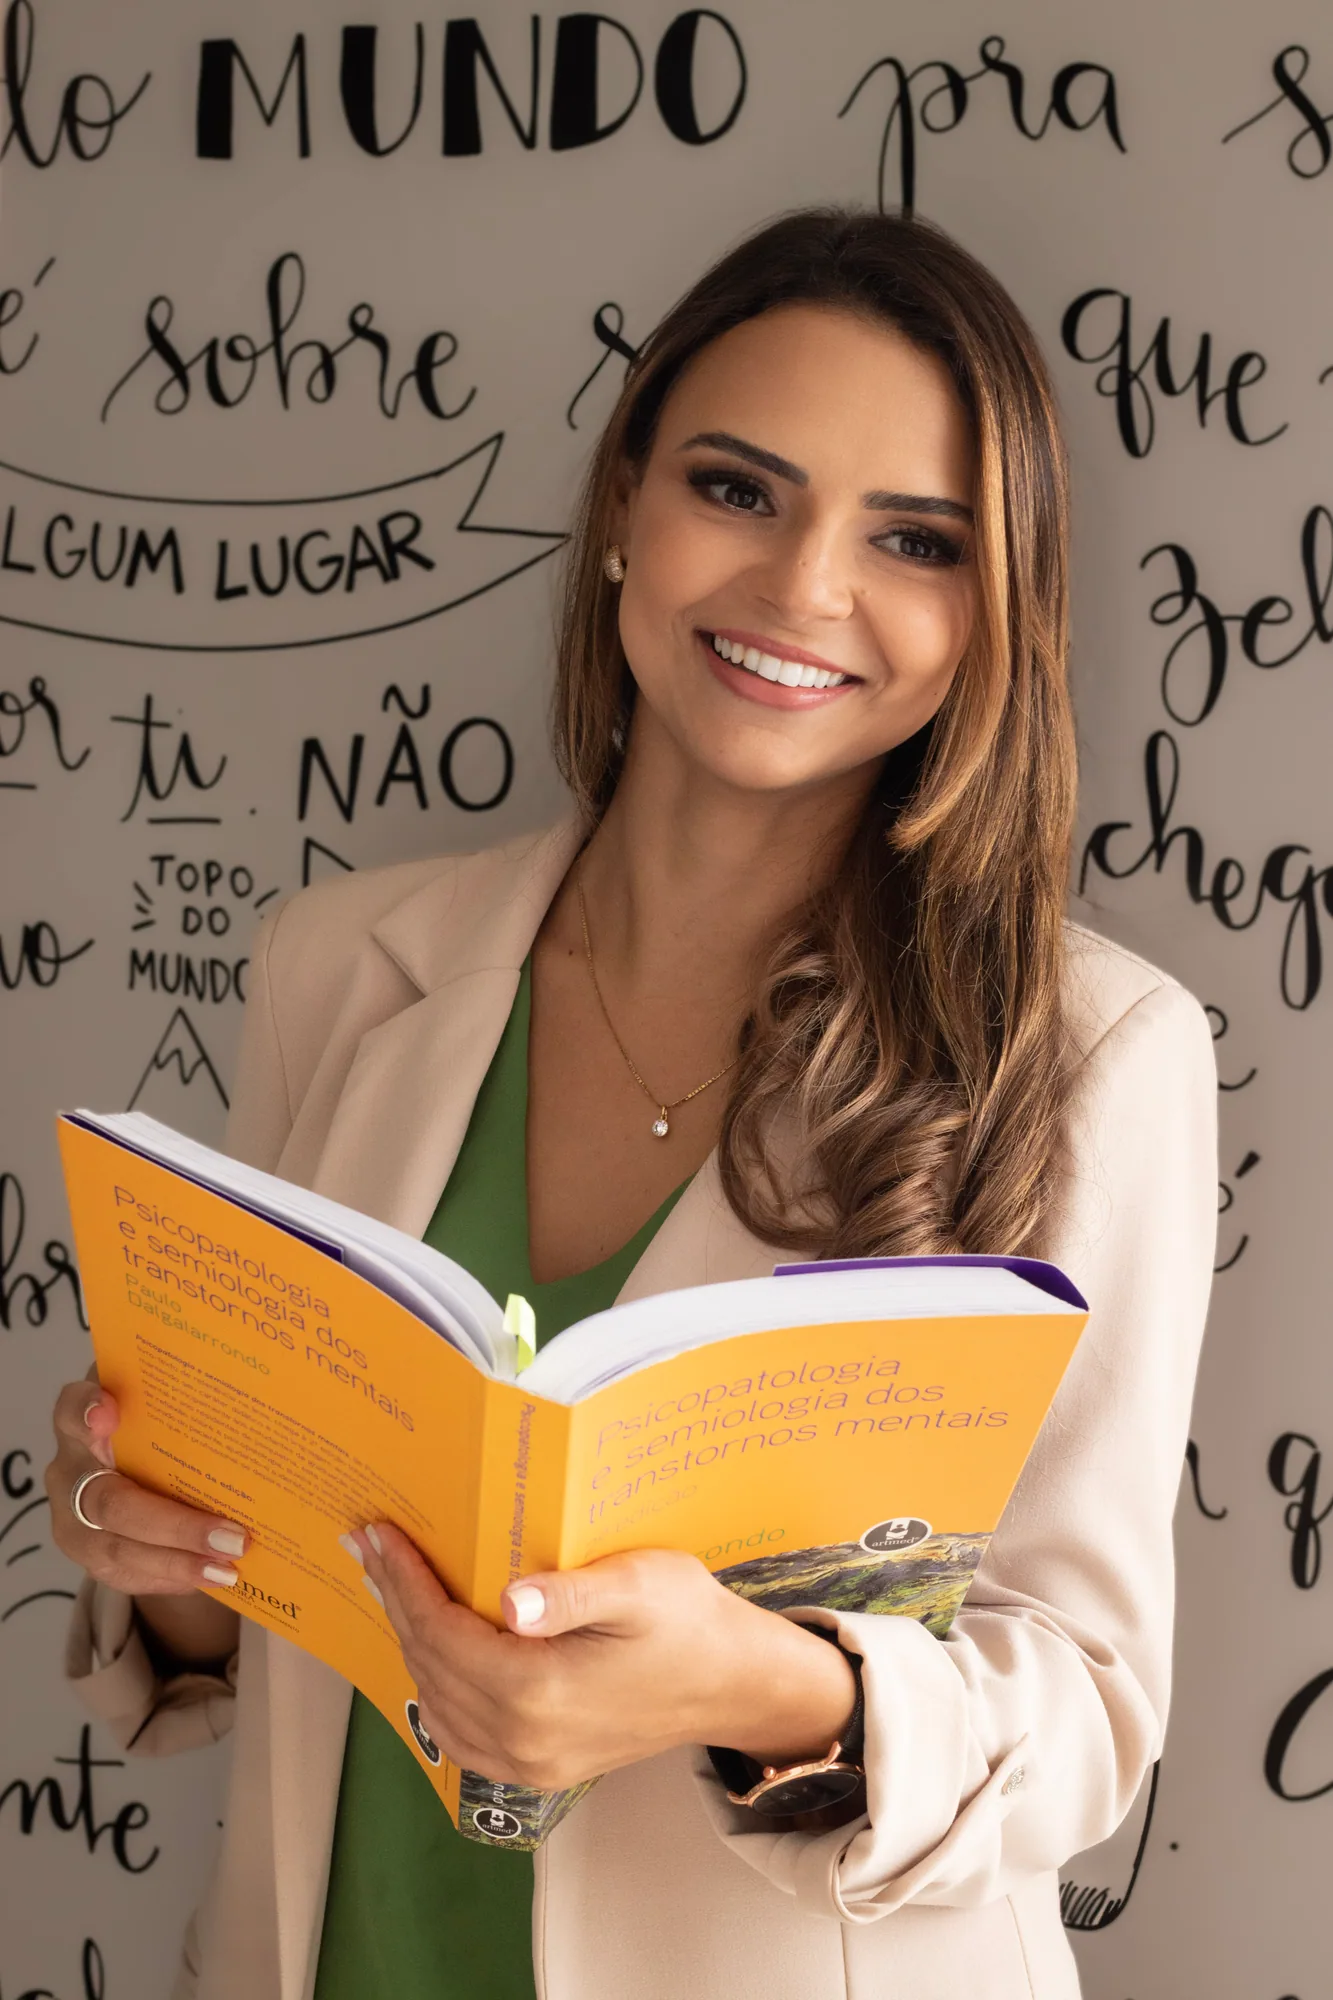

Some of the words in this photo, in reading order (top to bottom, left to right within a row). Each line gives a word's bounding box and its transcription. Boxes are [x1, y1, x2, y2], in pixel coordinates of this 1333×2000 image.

[196, 9, 748, 160] MUNDO
[837, 35, 1127, 217] pra
[101, 252, 477, 424] sobre
[1061, 288, 1289, 458] que
[215, 510, 436, 600] LUGAR
[298, 683, 516, 824] NÃO
[150, 854, 254, 899] TOPO
[182, 905, 231, 937] DO
[114, 1185, 331, 1320] Psicopatologia
[119, 1221, 136, 1241] e
[147, 1234, 306, 1332] semiologia
[315, 1327, 368, 1370] dos
[125, 1273, 182, 1314] Paulo
[122, 1245, 296, 1352] transtornos
[306, 1345, 415, 1433] mentais
[127, 1290, 271, 1377] Dalgalarrondo
[592, 1465, 612, 1490] e
[624, 1383, 850, 1469] semiologia
[865, 1381, 947, 1406] dos
[596, 1355, 903, 1458] Psicopatologia
[589, 1424, 818, 1525] transtornos
[834, 1405, 1010, 1438] mentais
